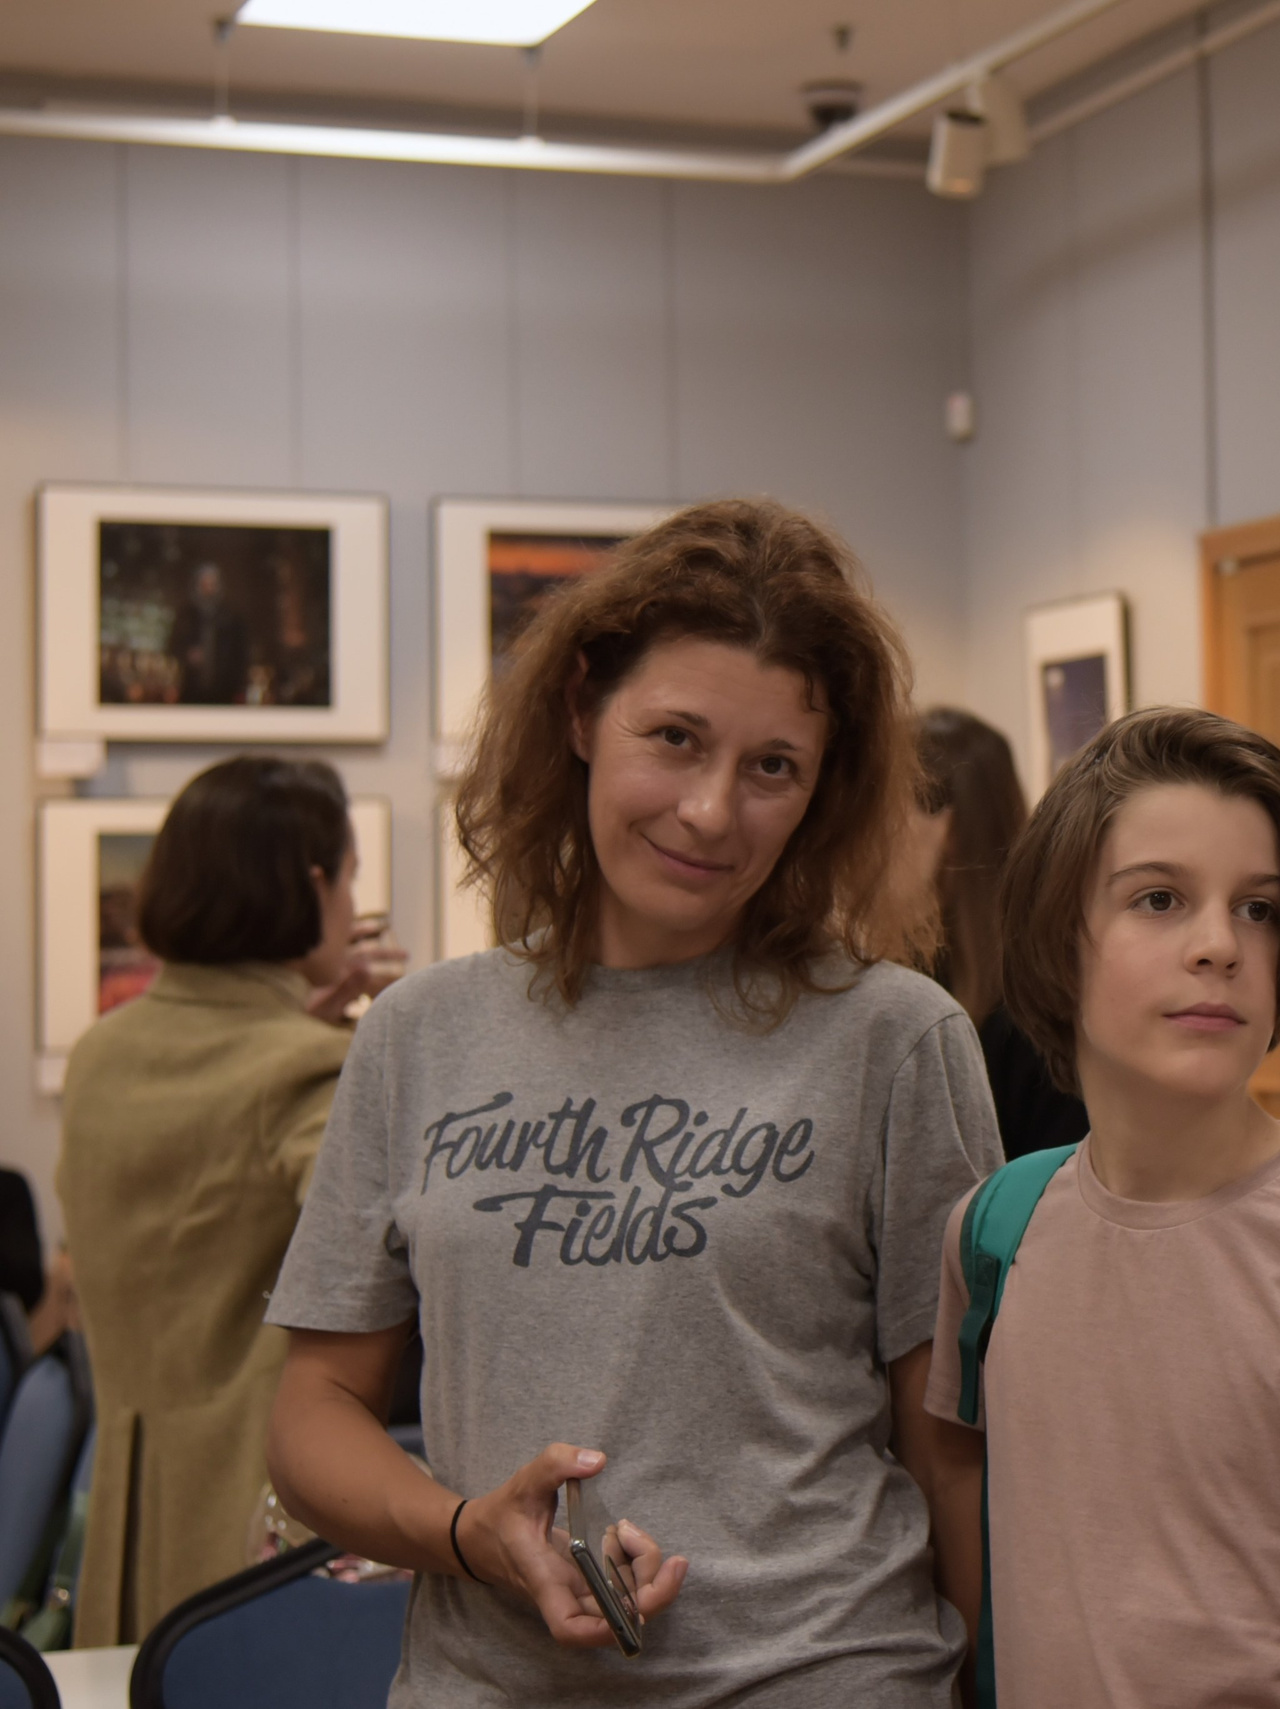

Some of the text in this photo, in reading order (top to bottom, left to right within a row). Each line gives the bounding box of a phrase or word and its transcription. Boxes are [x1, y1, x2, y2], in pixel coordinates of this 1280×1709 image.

[421, 1092, 815, 1198] Fourth Ridge
[472, 1184, 718, 1267] Fields
